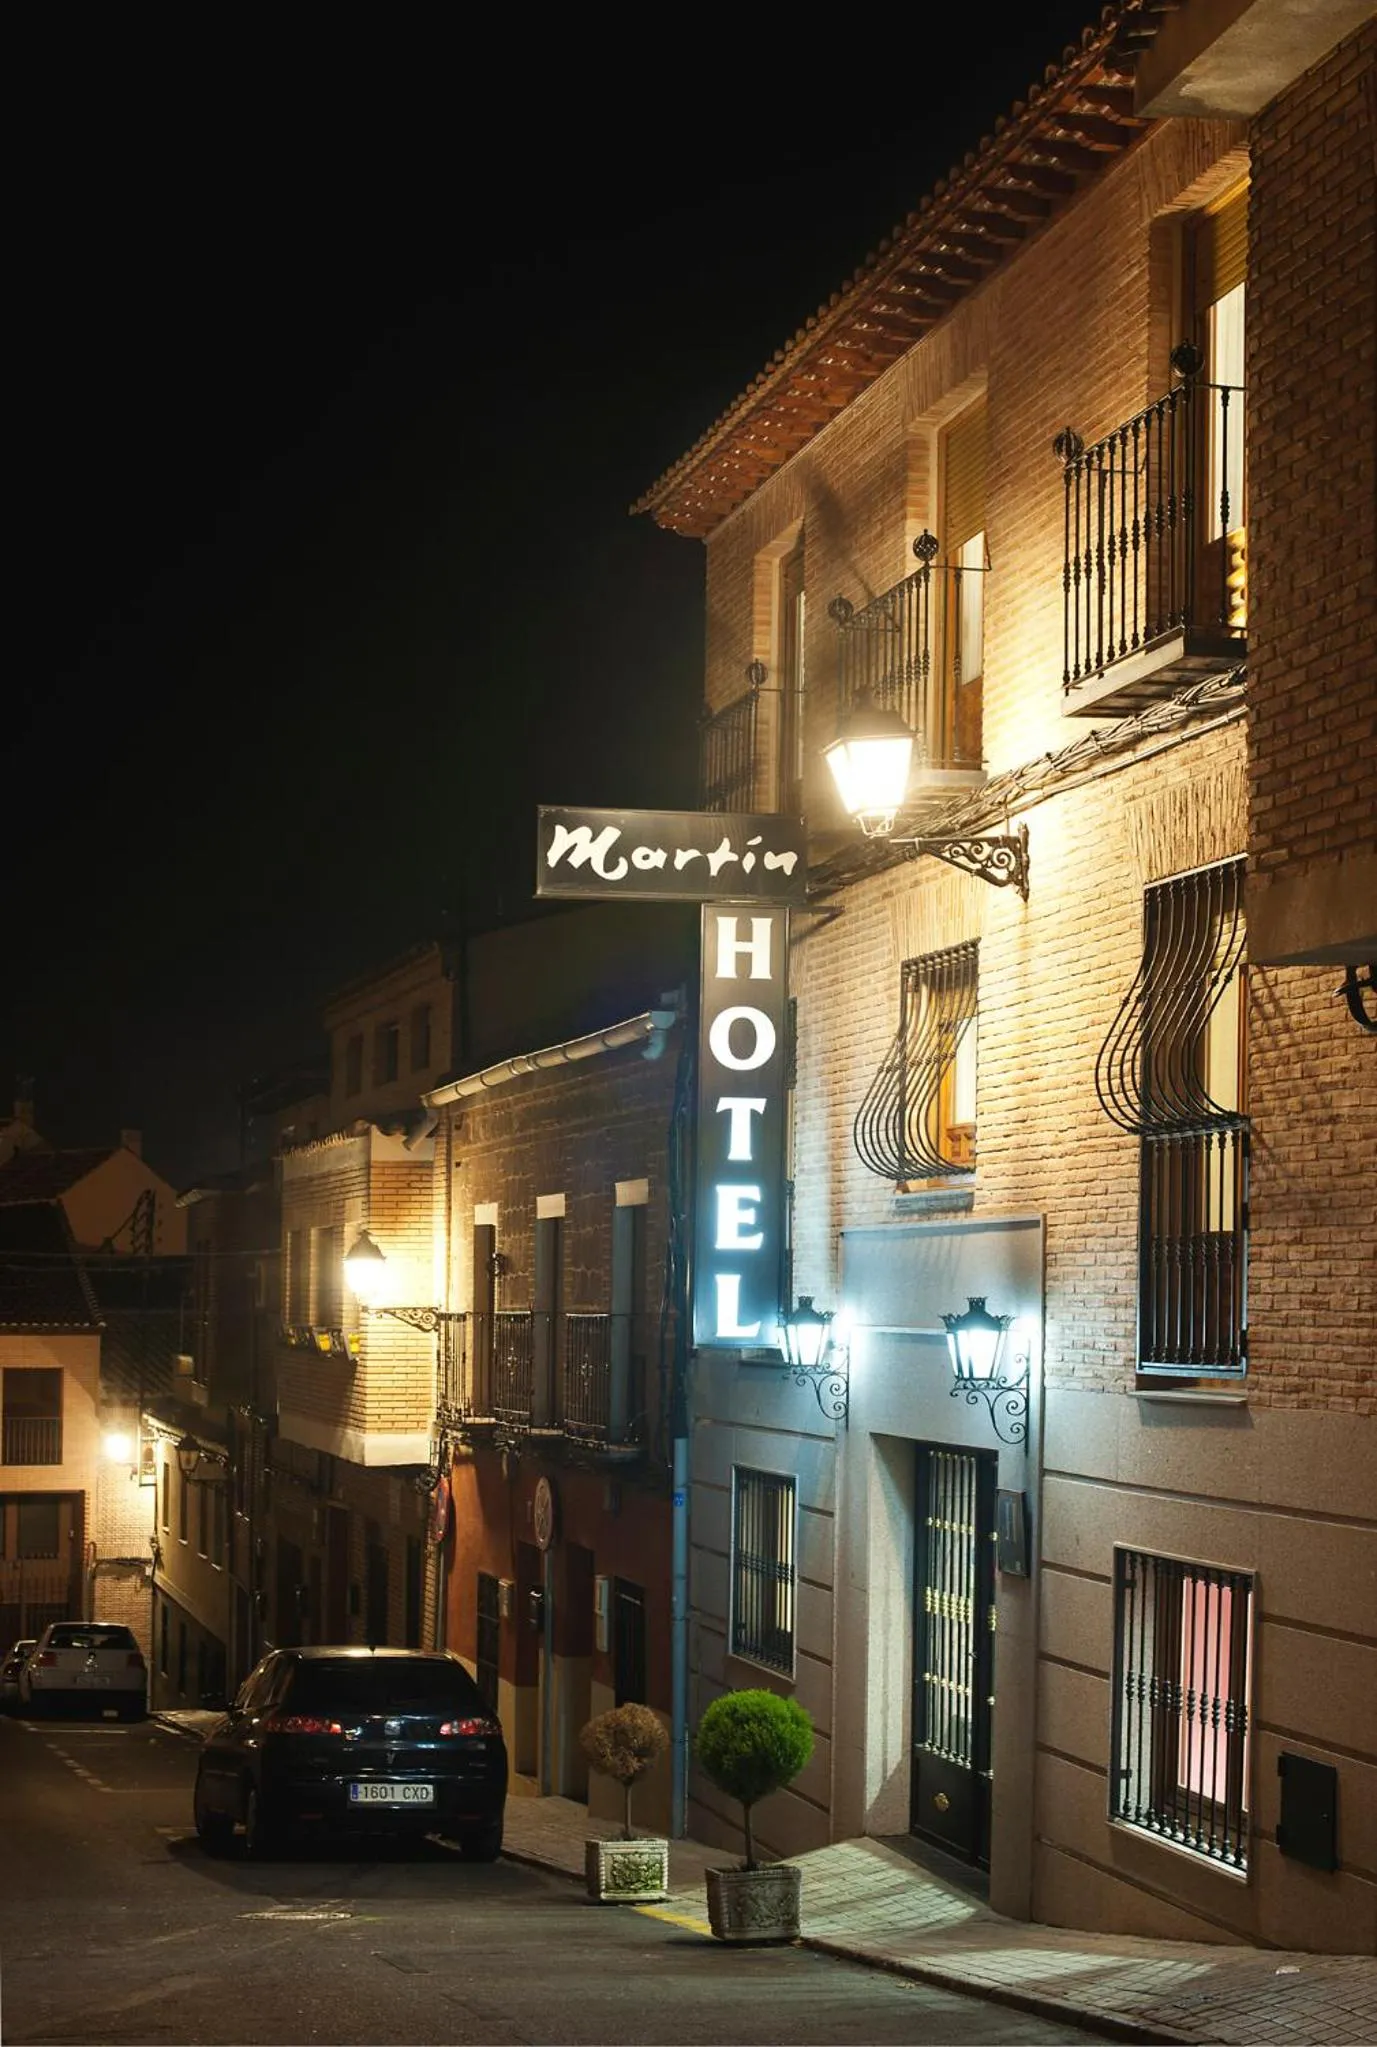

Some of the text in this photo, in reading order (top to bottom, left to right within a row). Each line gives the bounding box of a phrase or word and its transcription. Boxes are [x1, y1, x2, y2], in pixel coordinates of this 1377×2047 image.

[546, 824, 798, 880] Martín
[709, 916, 776, 1338] HOTEL
[363, 1786, 430, 1800] 1601 CXD
